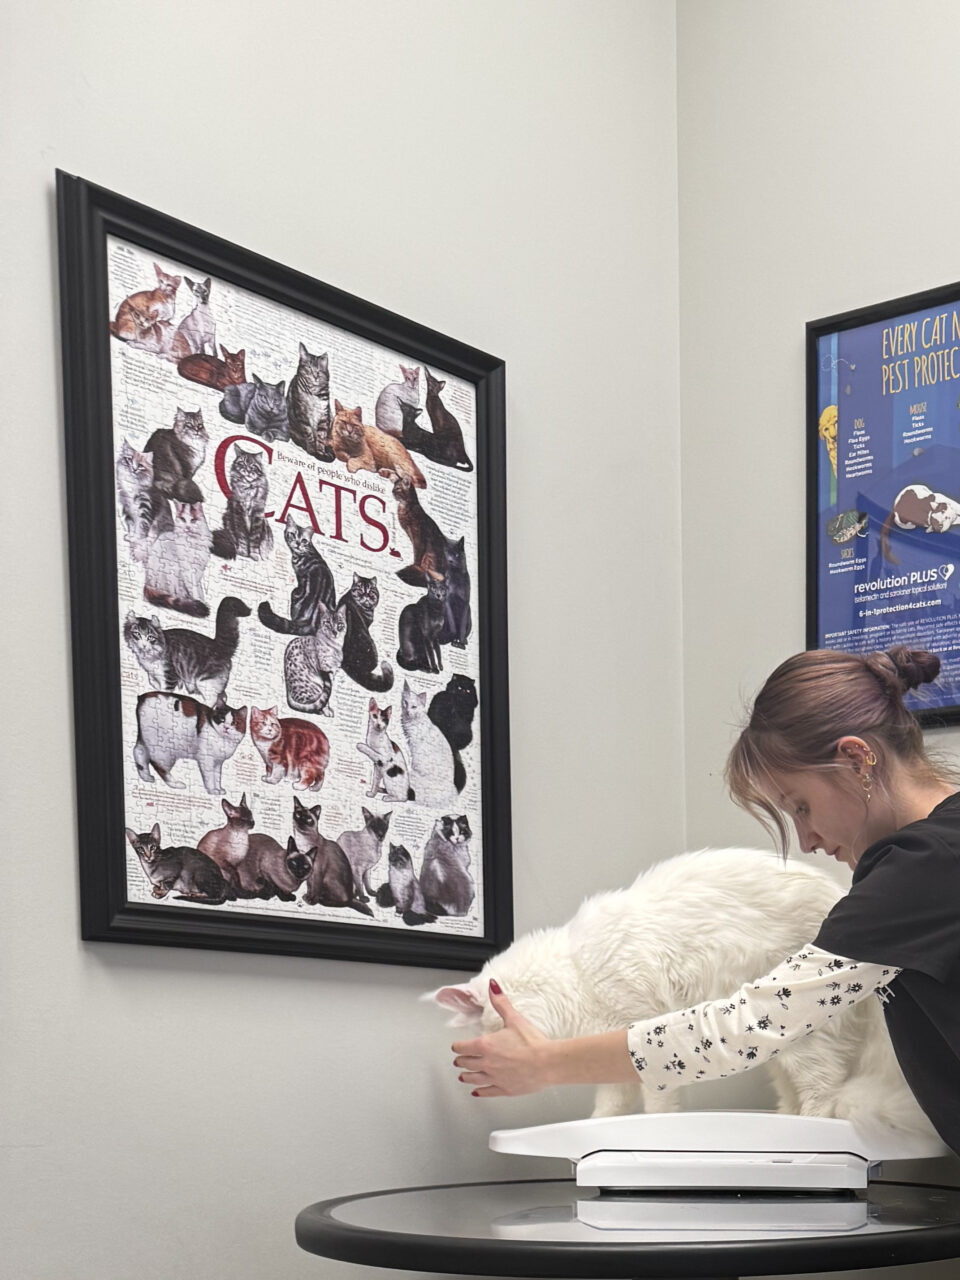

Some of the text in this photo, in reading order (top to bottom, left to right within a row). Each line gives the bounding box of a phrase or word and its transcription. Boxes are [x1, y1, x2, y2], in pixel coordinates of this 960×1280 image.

[882, 321, 918, 359] EVERY
[921, 313, 948, 349] CAT
[882, 359, 909, 396] PEST
[277, 451, 305, 468] Beware
[317, 466, 342, 480] people
[344, 475, 360, 486] who
[362, 480, 385, 494] dislike
[910, 569, 938, 584] PLUS
[859, 599, 942, 617] 6-in-1protection4cats.com
